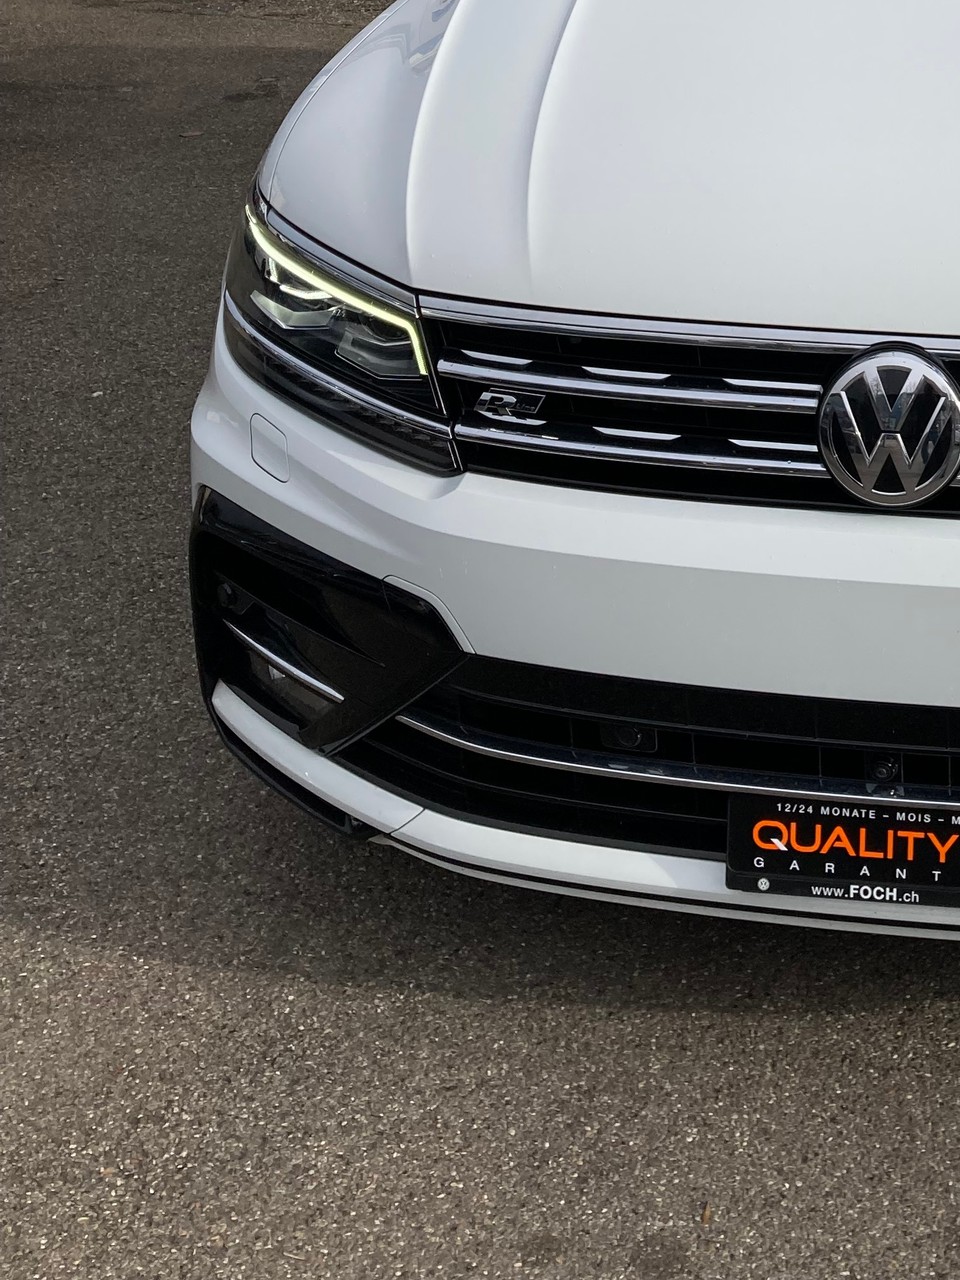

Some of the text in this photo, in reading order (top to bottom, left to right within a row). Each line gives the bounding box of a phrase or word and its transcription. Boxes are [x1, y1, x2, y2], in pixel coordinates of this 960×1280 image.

[776, 803, 813, 814] 12/24
[820, 806, 876, 819] MONATE
[896, 811, 931, 823] MOIS
[752, 819, 960, 863] QUALITY
[811, 885, 920, 903] www.FOCH.ch
